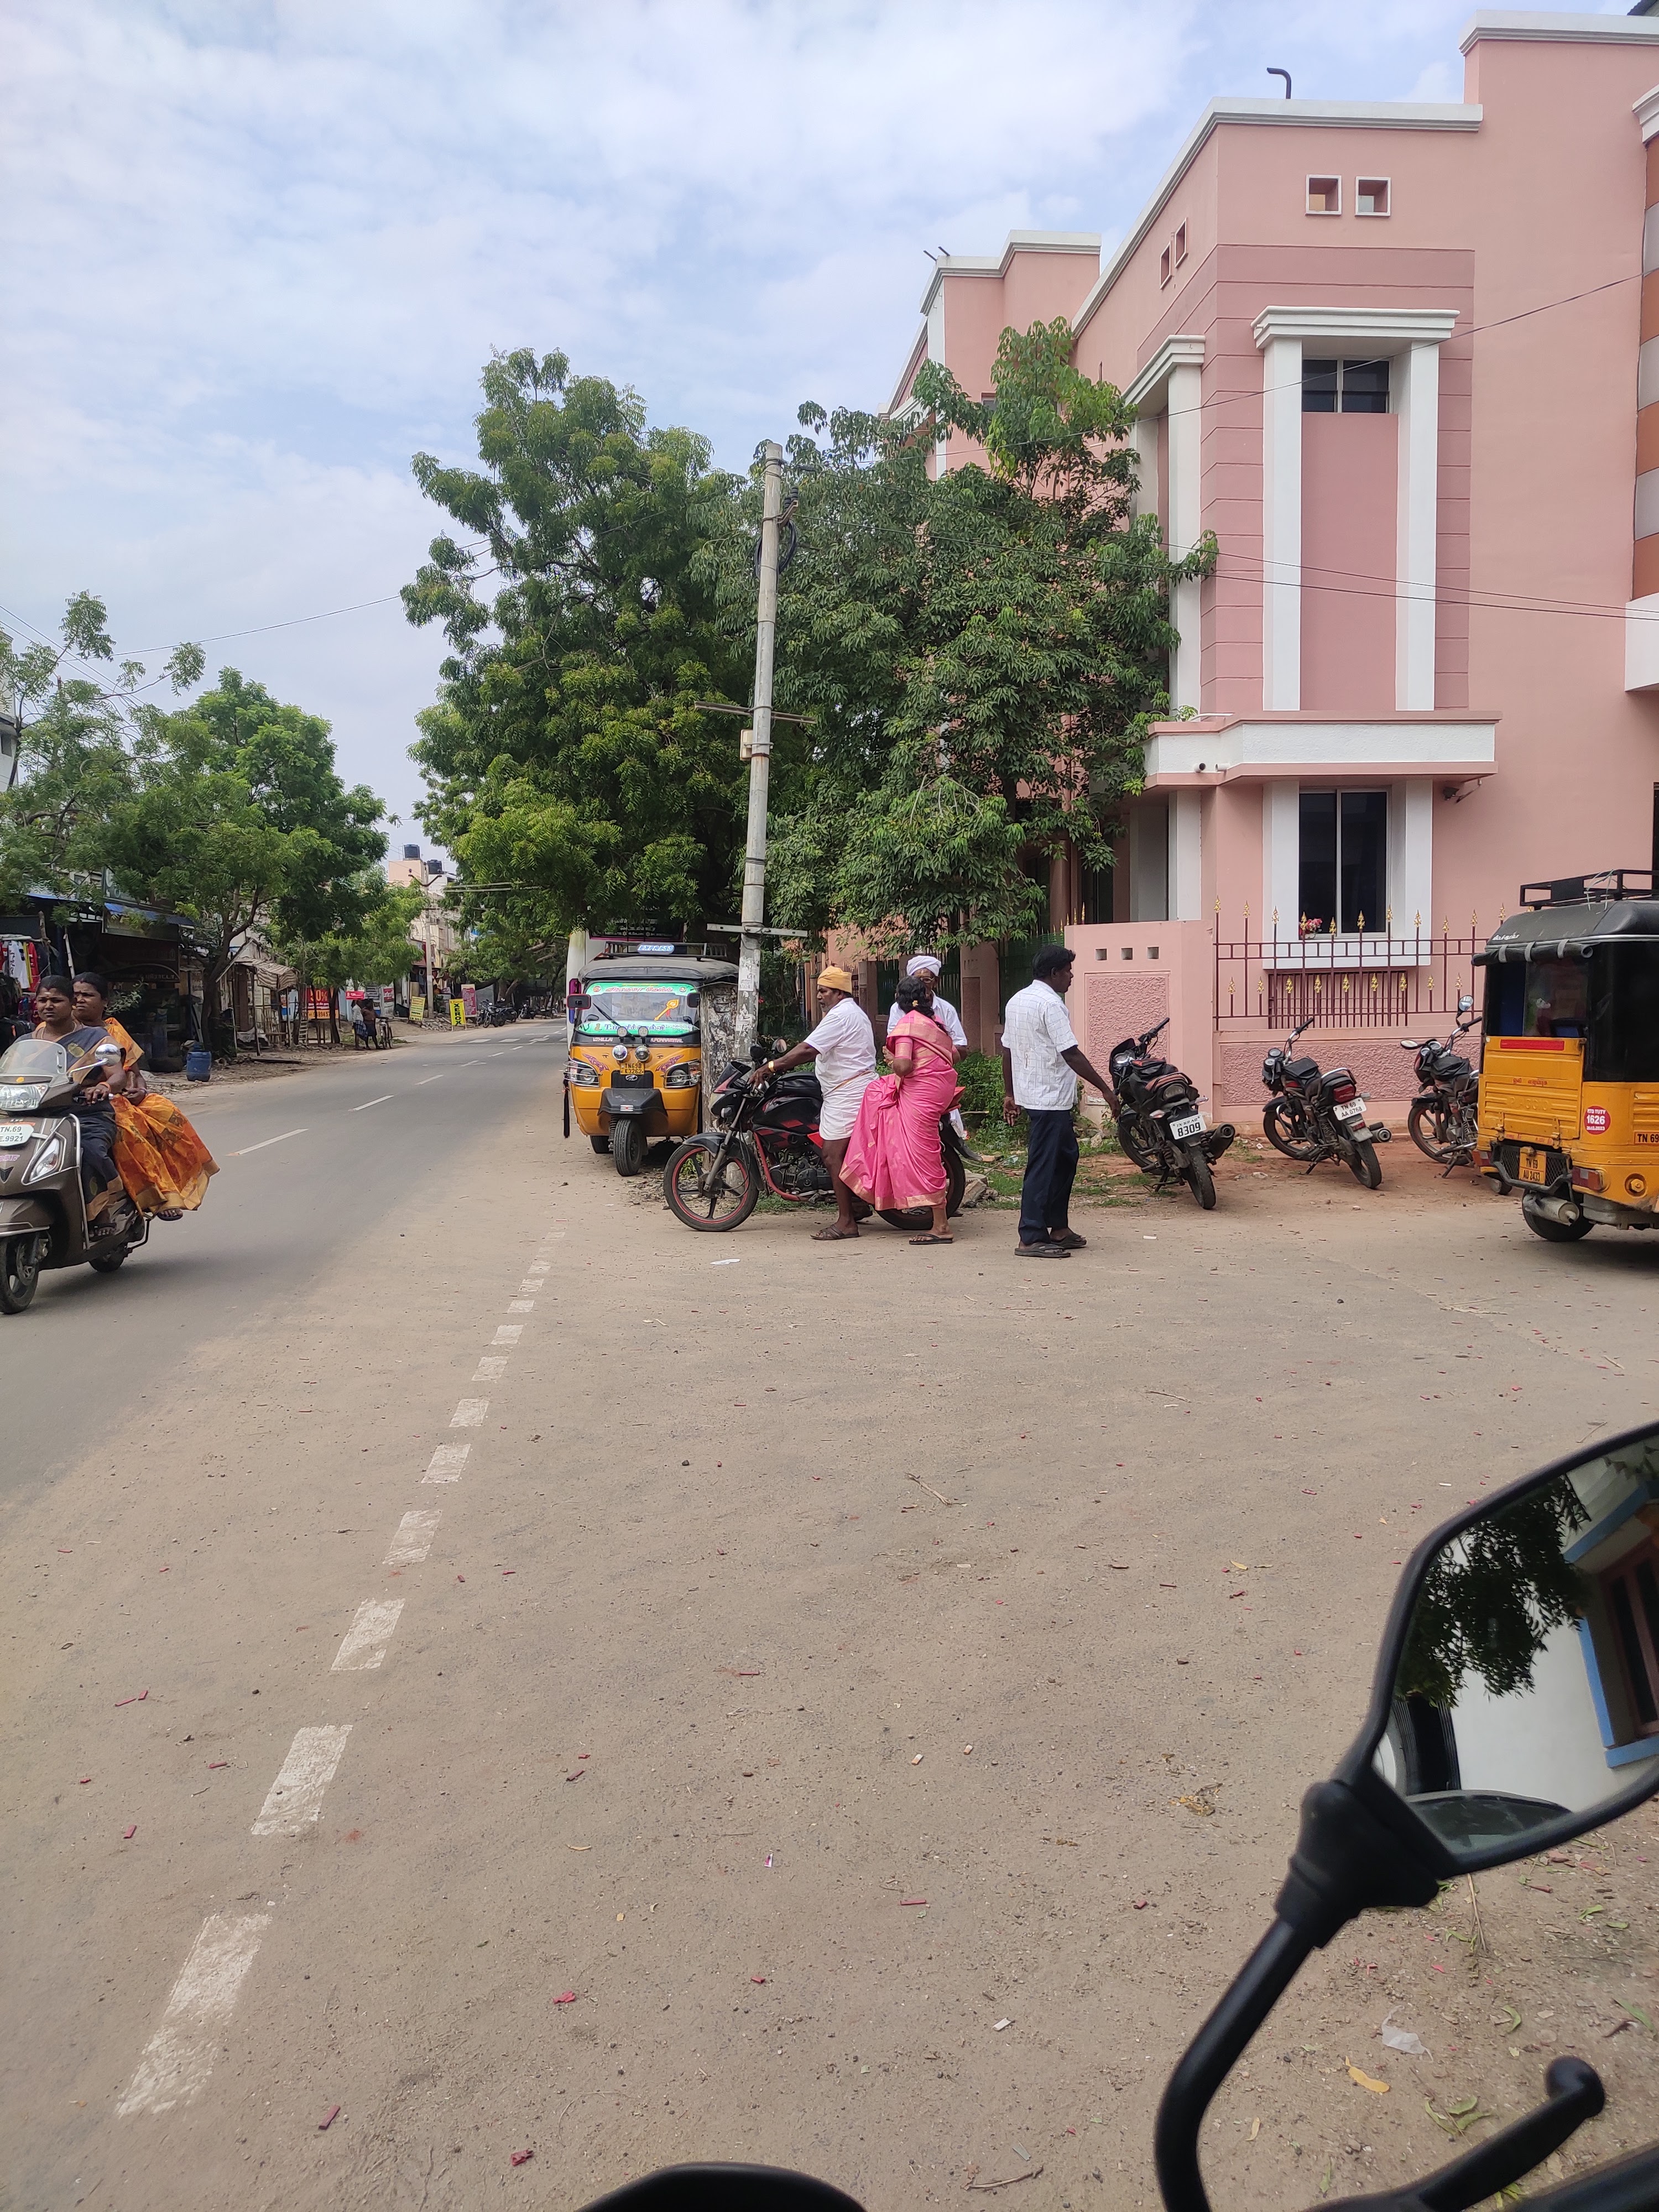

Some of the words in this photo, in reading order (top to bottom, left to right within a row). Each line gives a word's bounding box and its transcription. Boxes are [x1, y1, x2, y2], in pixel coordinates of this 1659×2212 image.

[453, 1003, 462, 1026] XEROX
[1586, 1114, 1605, 1125] 1626
[1177, 1121, 1201, 1137] 8309
[1637, 1133, 1648, 1143] TN
[1650, 1134, 1659, 1143] 69
